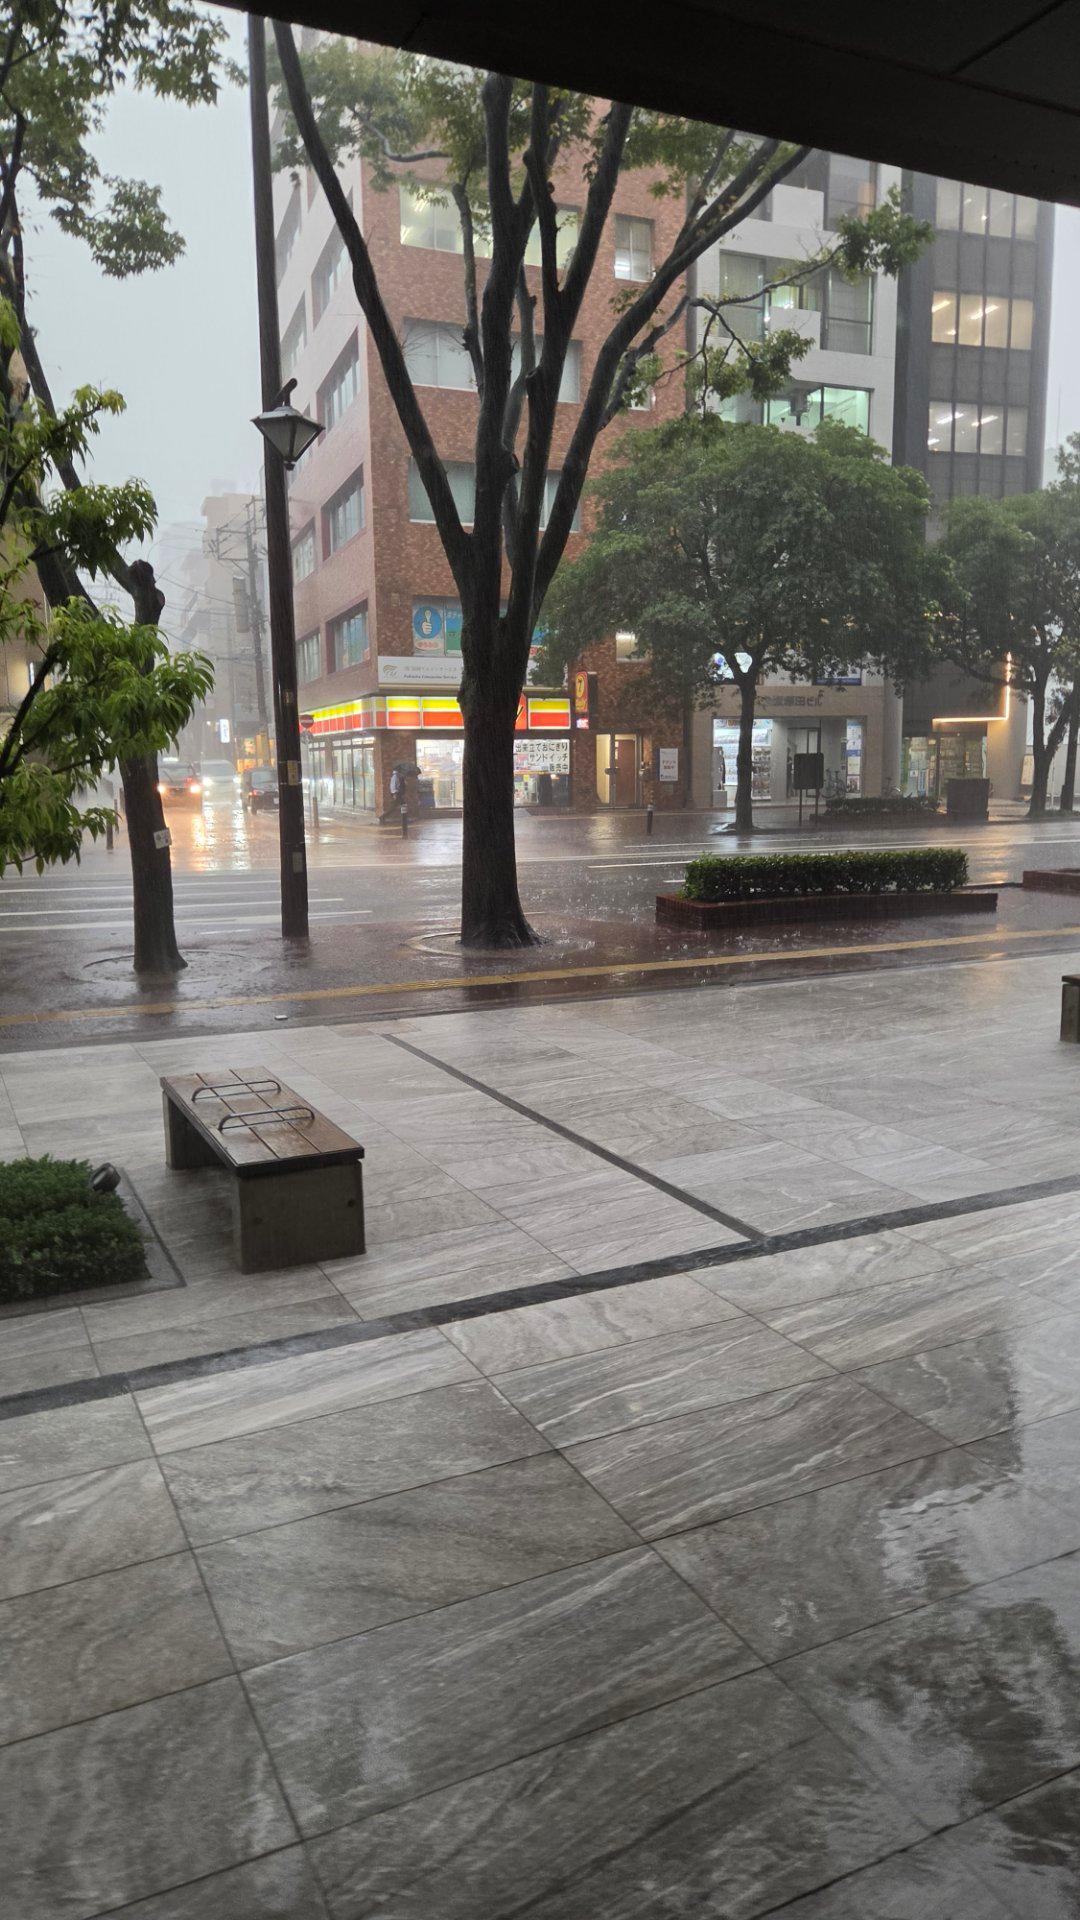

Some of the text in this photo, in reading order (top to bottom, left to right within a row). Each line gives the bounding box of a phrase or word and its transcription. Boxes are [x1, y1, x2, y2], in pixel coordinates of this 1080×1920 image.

[515, 742, 568, 753] 出来立ておにぎり
[529, 753, 568, 762] サンドイッチ
[549, 763, 568, 772] 販売中
